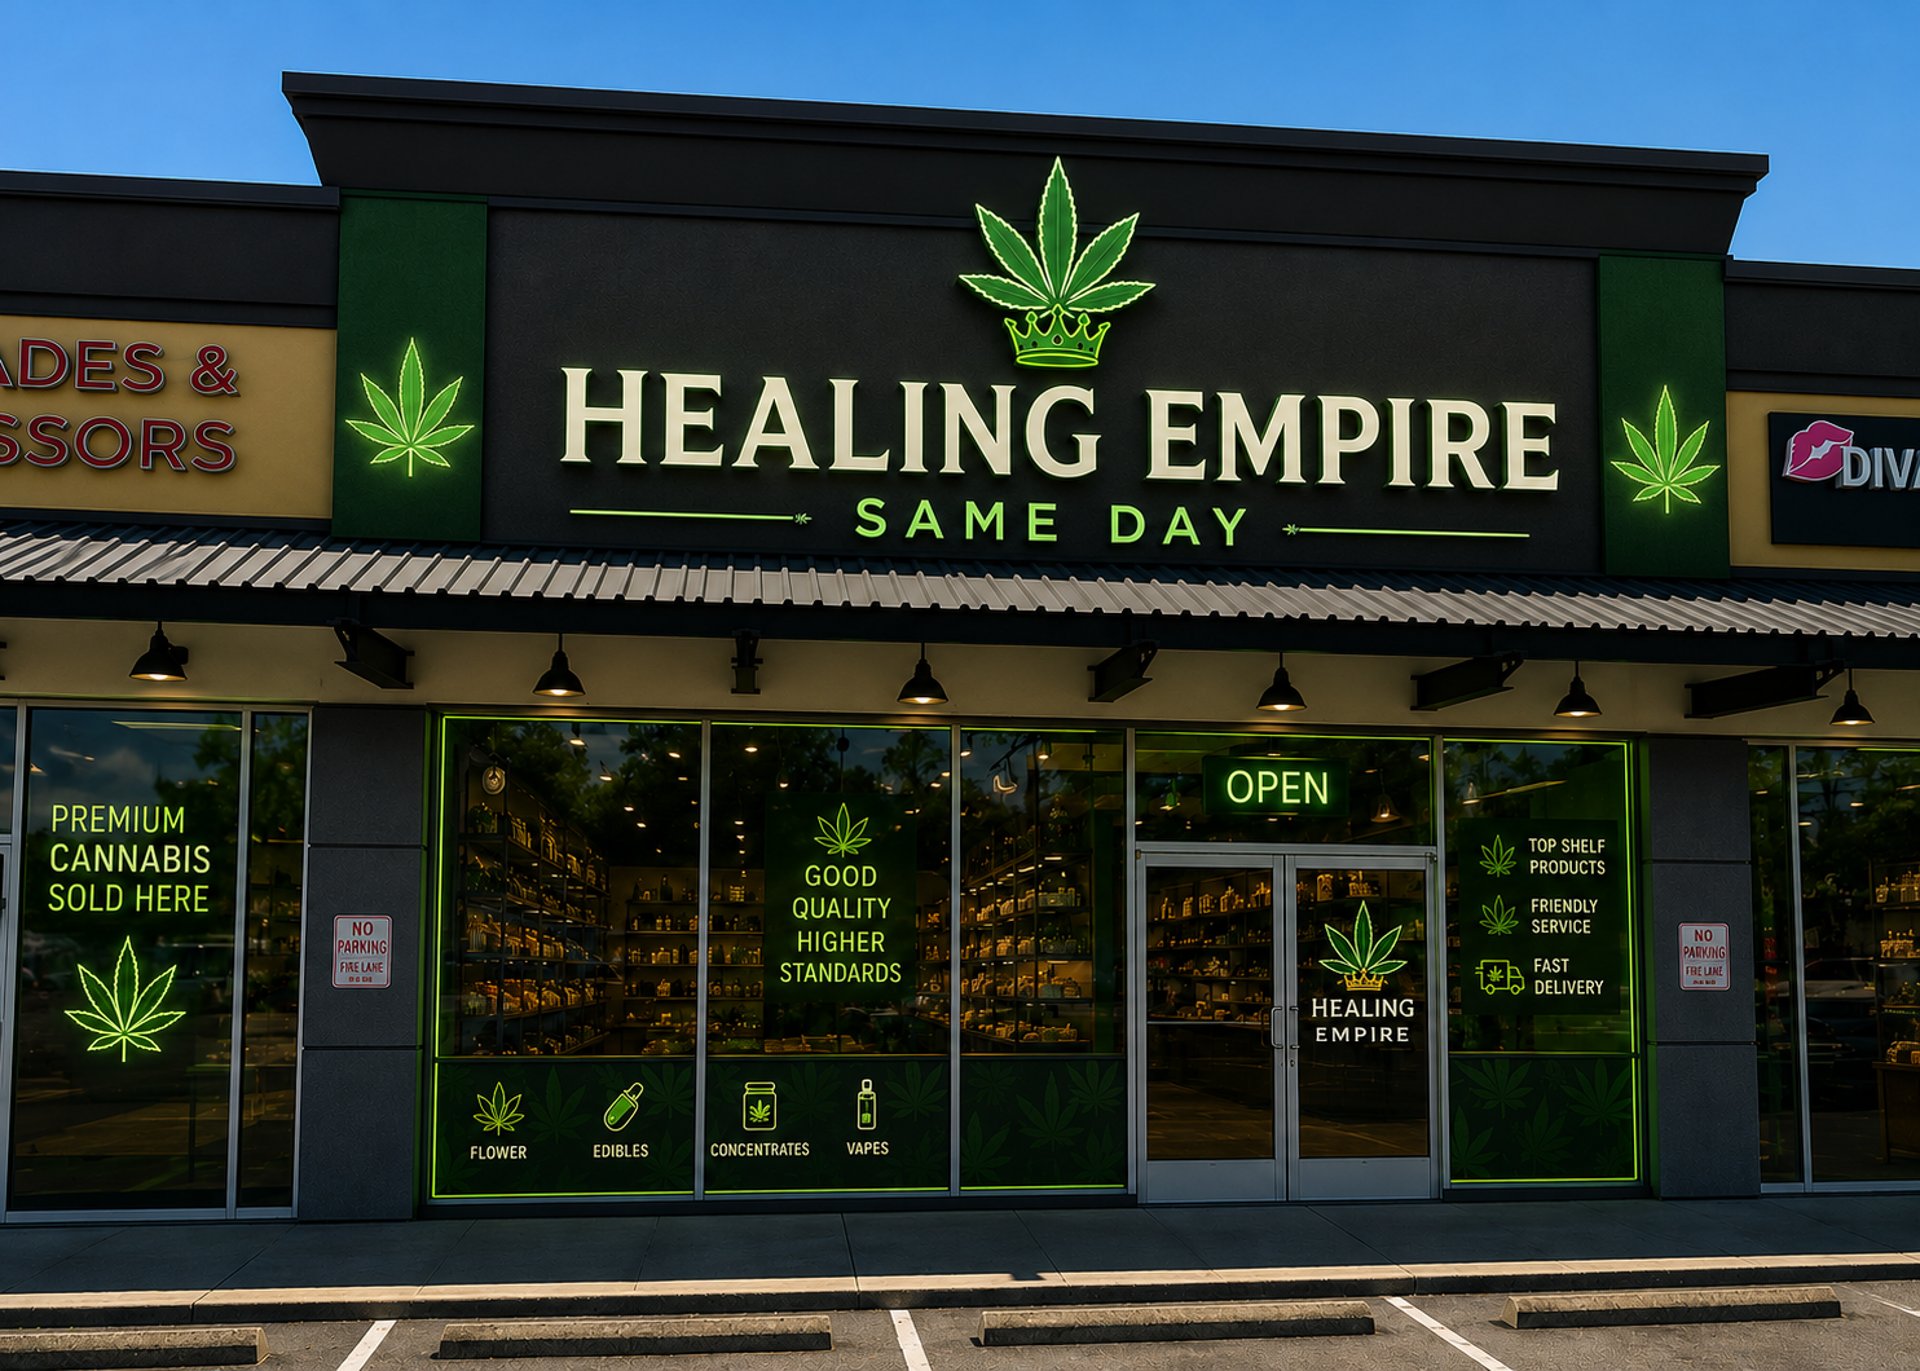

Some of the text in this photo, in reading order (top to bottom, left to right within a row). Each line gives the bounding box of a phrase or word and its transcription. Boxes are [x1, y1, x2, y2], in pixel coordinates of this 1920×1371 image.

[0, 337, 239, 395] DES &
[559, 366, 1560, 492] HEALING EMPIRE
[855, 497, 1248, 547] SAME DAY
[1227, 770, 1328, 805] OPEN
[52, 804, 185, 834] PREMIUM
[1528, 837, 1605, 854] TOP SHELF
[50, 843, 210, 874] CANNABIS
[1529, 859, 1606, 875] PRODUCTS
[805, 864, 877, 887] GOOD
[48, 883, 209, 913] SOLD HERE
[1531, 898, 1598, 914] FRIENDLY
[792, 896, 891, 921] QUALITY
[352, 921, 373, 936] NO
[1531, 918, 1591, 934] SERVICE
[797, 930, 885, 953] HIGHER
[1695, 929, 1713, 942] NO
[338, 939, 387, 954] PARKING
[780, 962, 902, 983] STANDARDS
[1534, 957, 1570, 974] FAST
[1534, 979, 1604, 995] DELIVERY
[1311, 997, 1415, 1019] HEALING
[1316, 1026, 1410, 1043] EMPIRE
[470, 1145, 527, 1160] FLOWER
[593, 1143, 649, 1159] EDIBLES
[710, 1141, 810, 1158] CONCENTRATES
[846, 1141, 889, 1155] VAPES
